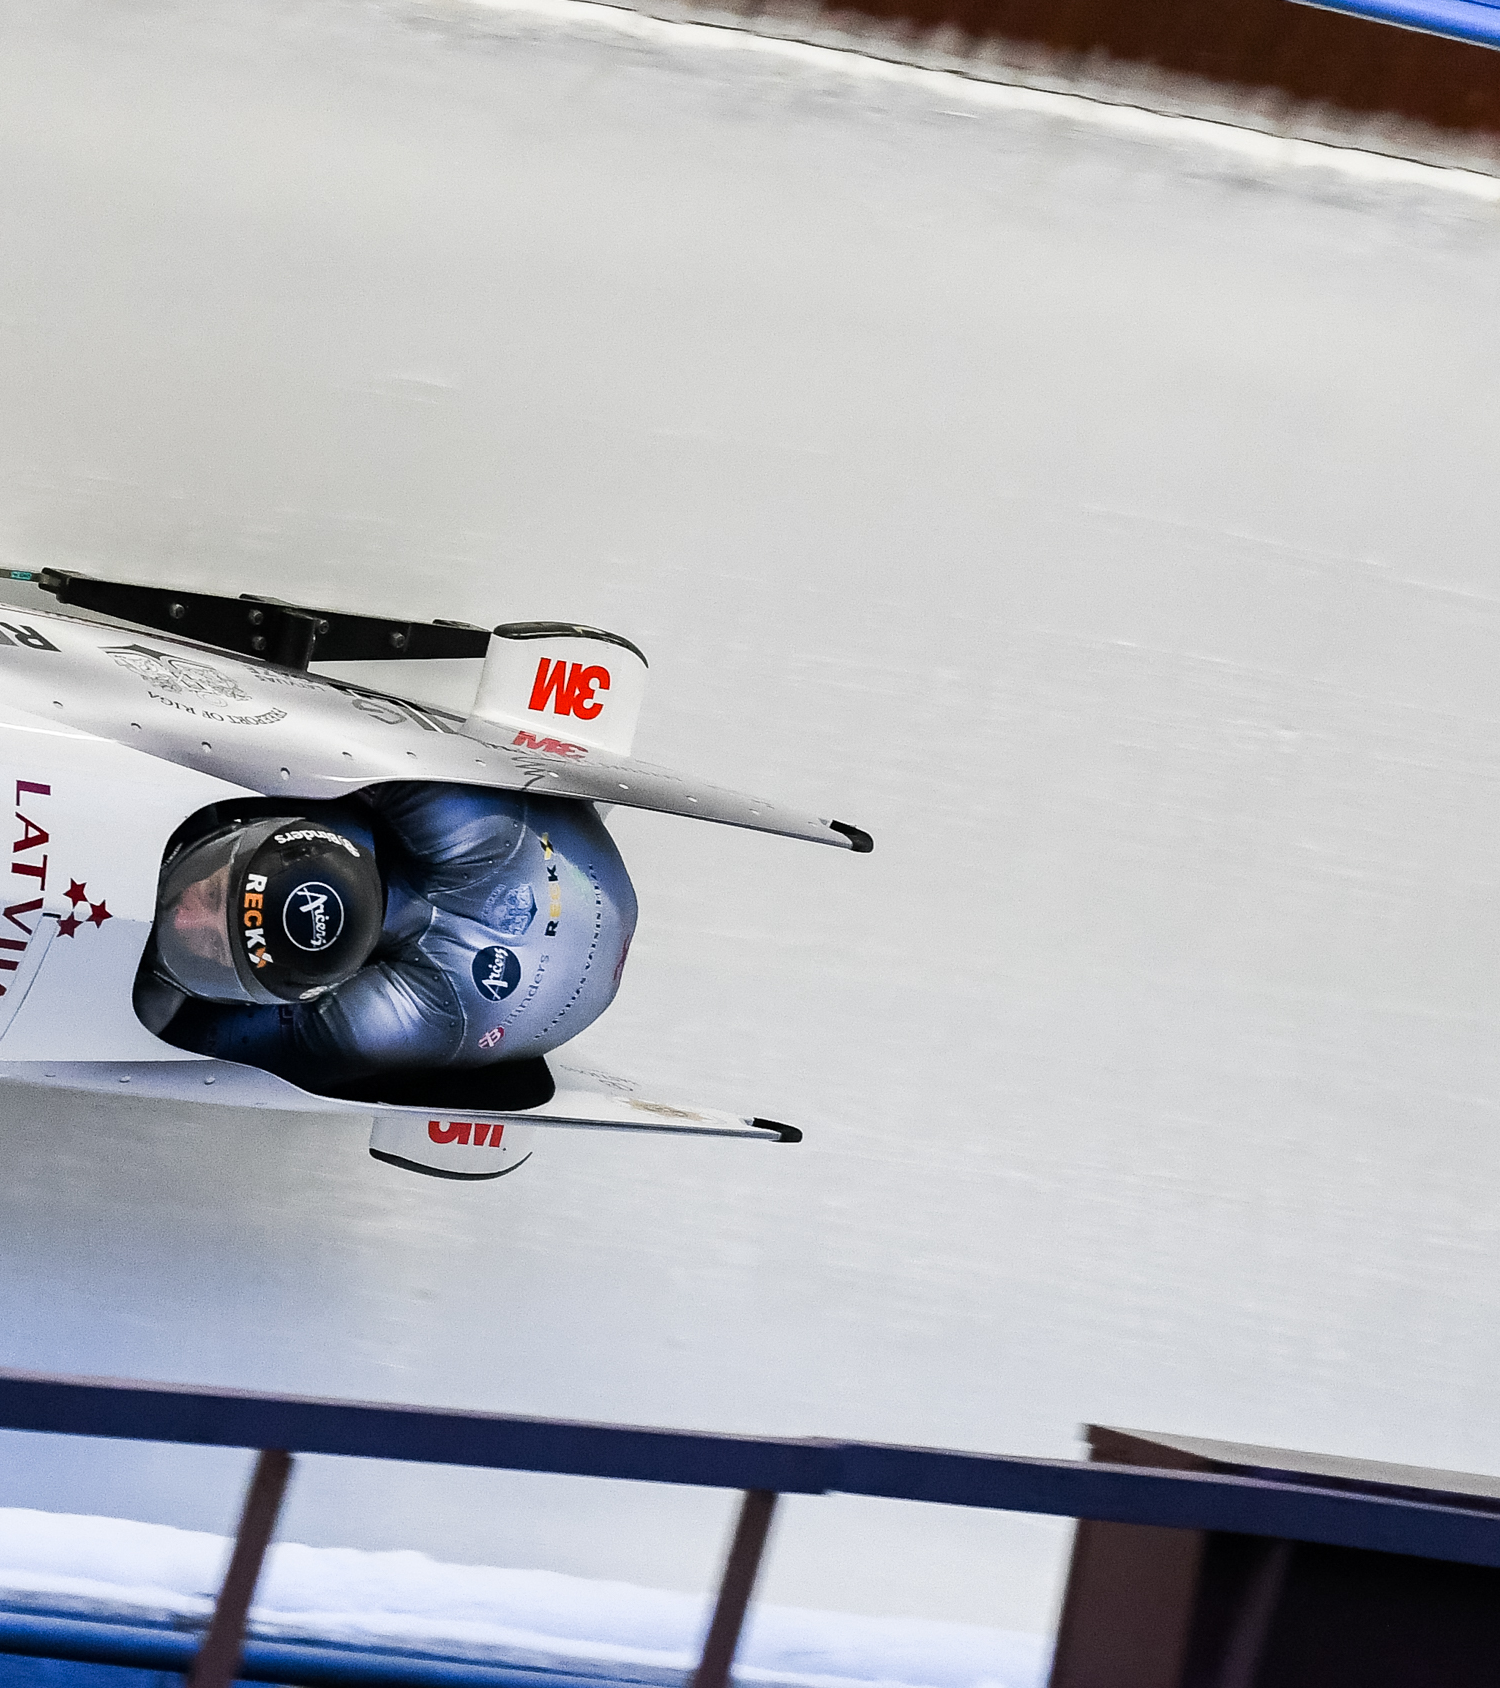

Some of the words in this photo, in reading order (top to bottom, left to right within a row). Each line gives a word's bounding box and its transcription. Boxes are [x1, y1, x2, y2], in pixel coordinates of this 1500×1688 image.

[528, 657, 611, 720] 3M
[147, 690, 197, 715] RIGA
[202, 710, 224, 722] OF
